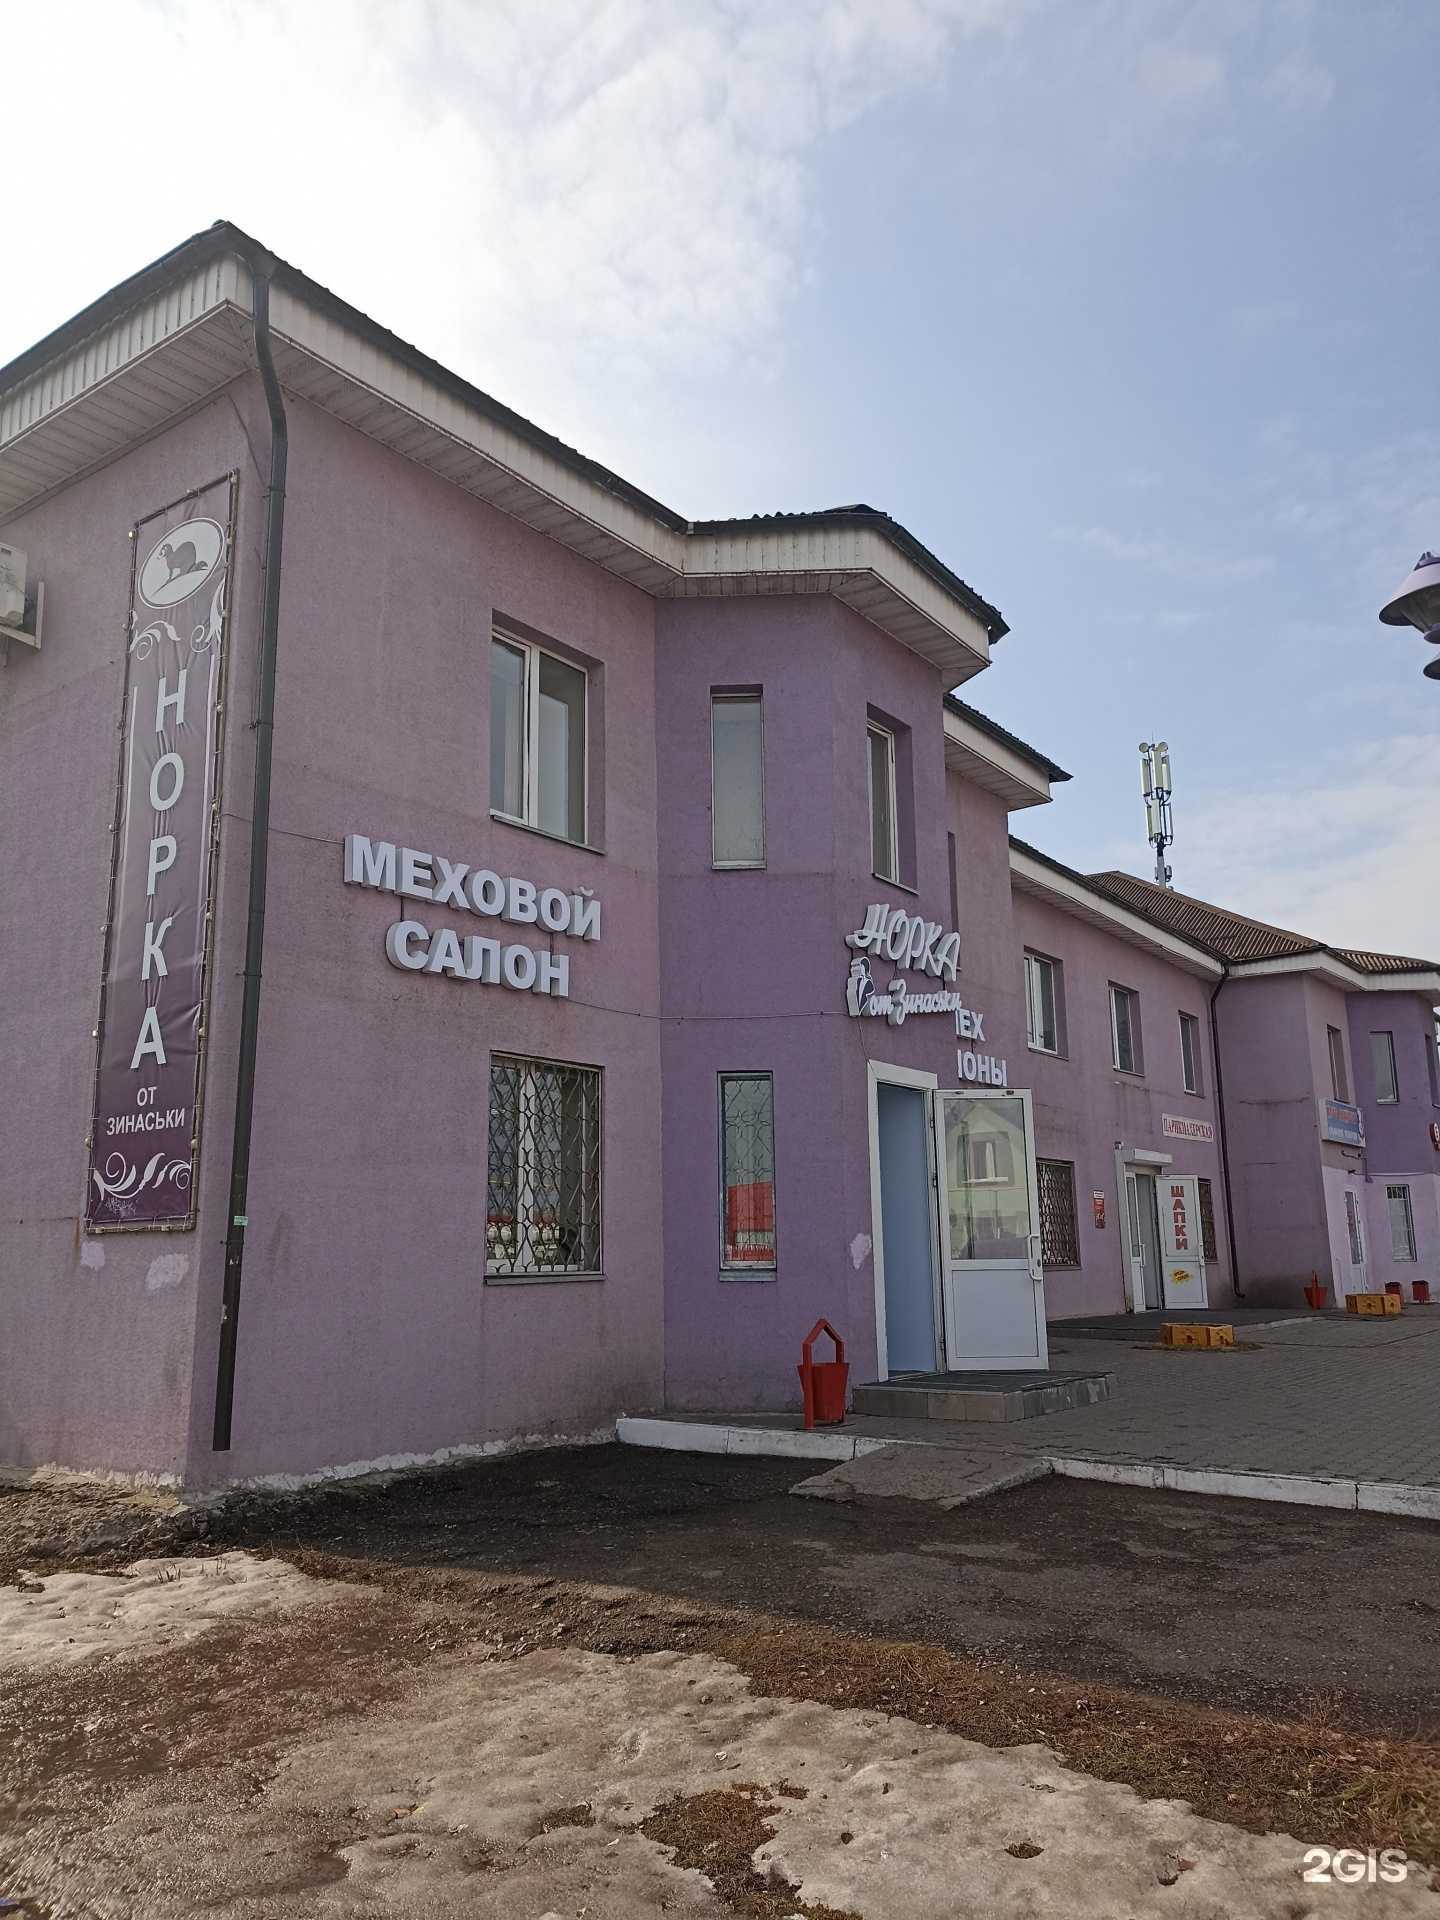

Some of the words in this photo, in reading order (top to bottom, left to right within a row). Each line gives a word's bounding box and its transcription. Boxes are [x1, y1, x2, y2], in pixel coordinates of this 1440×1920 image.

[129, 668, 188, 1069] НОРКА
[344, 834, 601, 941] МЕХОВОЙ
[386, 920, 570, 998] САЛОН
[846, 903, 961, 982] НОРКА
[869, 994, 892, 1017] от
[106, 1107, 186, 1136] ЗИНАСЬКИ
[136, 1086, 157, 1107] ОТ
[1171, 1185, 1188, 1250] ШАПКИ
